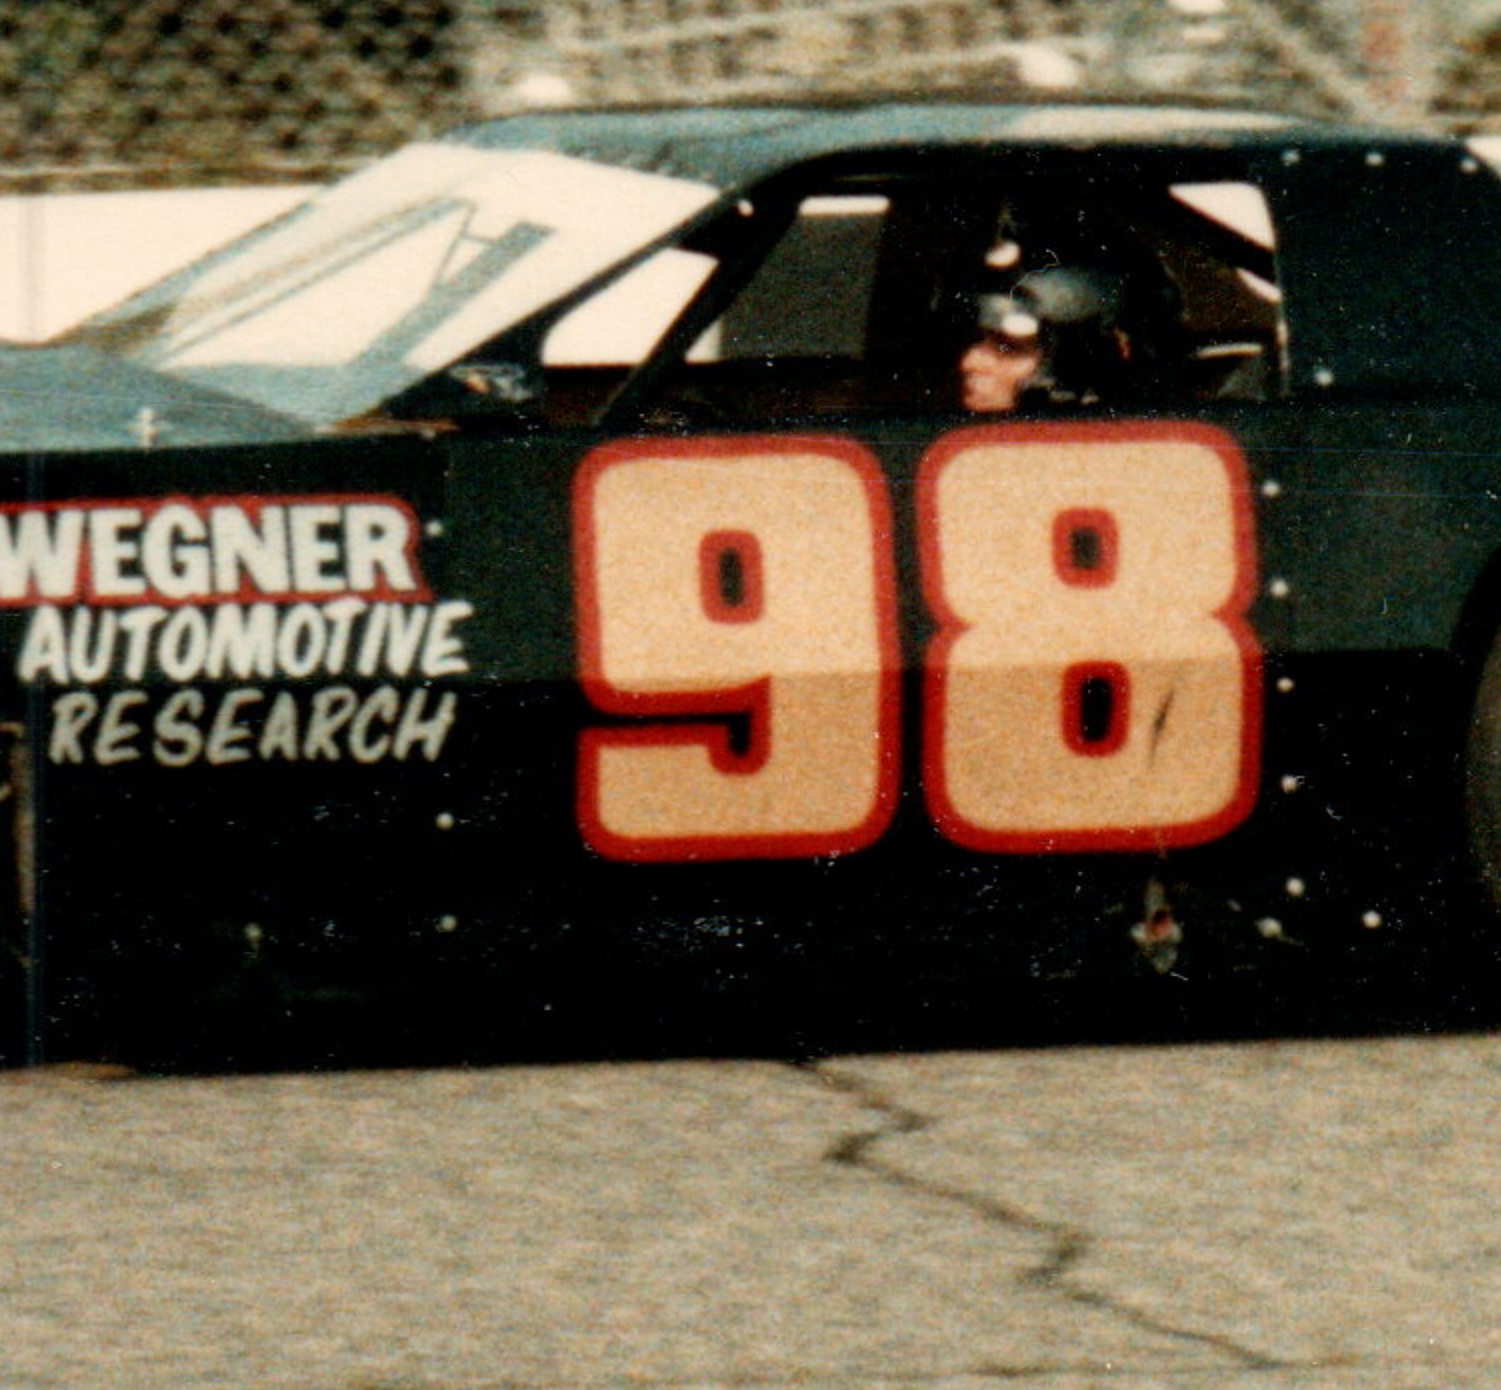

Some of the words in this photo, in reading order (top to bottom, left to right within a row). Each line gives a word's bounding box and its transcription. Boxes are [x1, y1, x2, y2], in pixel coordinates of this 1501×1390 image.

[17, 597, 474, 685] AUTOMOTIVE
[571, 418, 1265, 862] 98
[47, 685, 459, 768] RESEARCH
